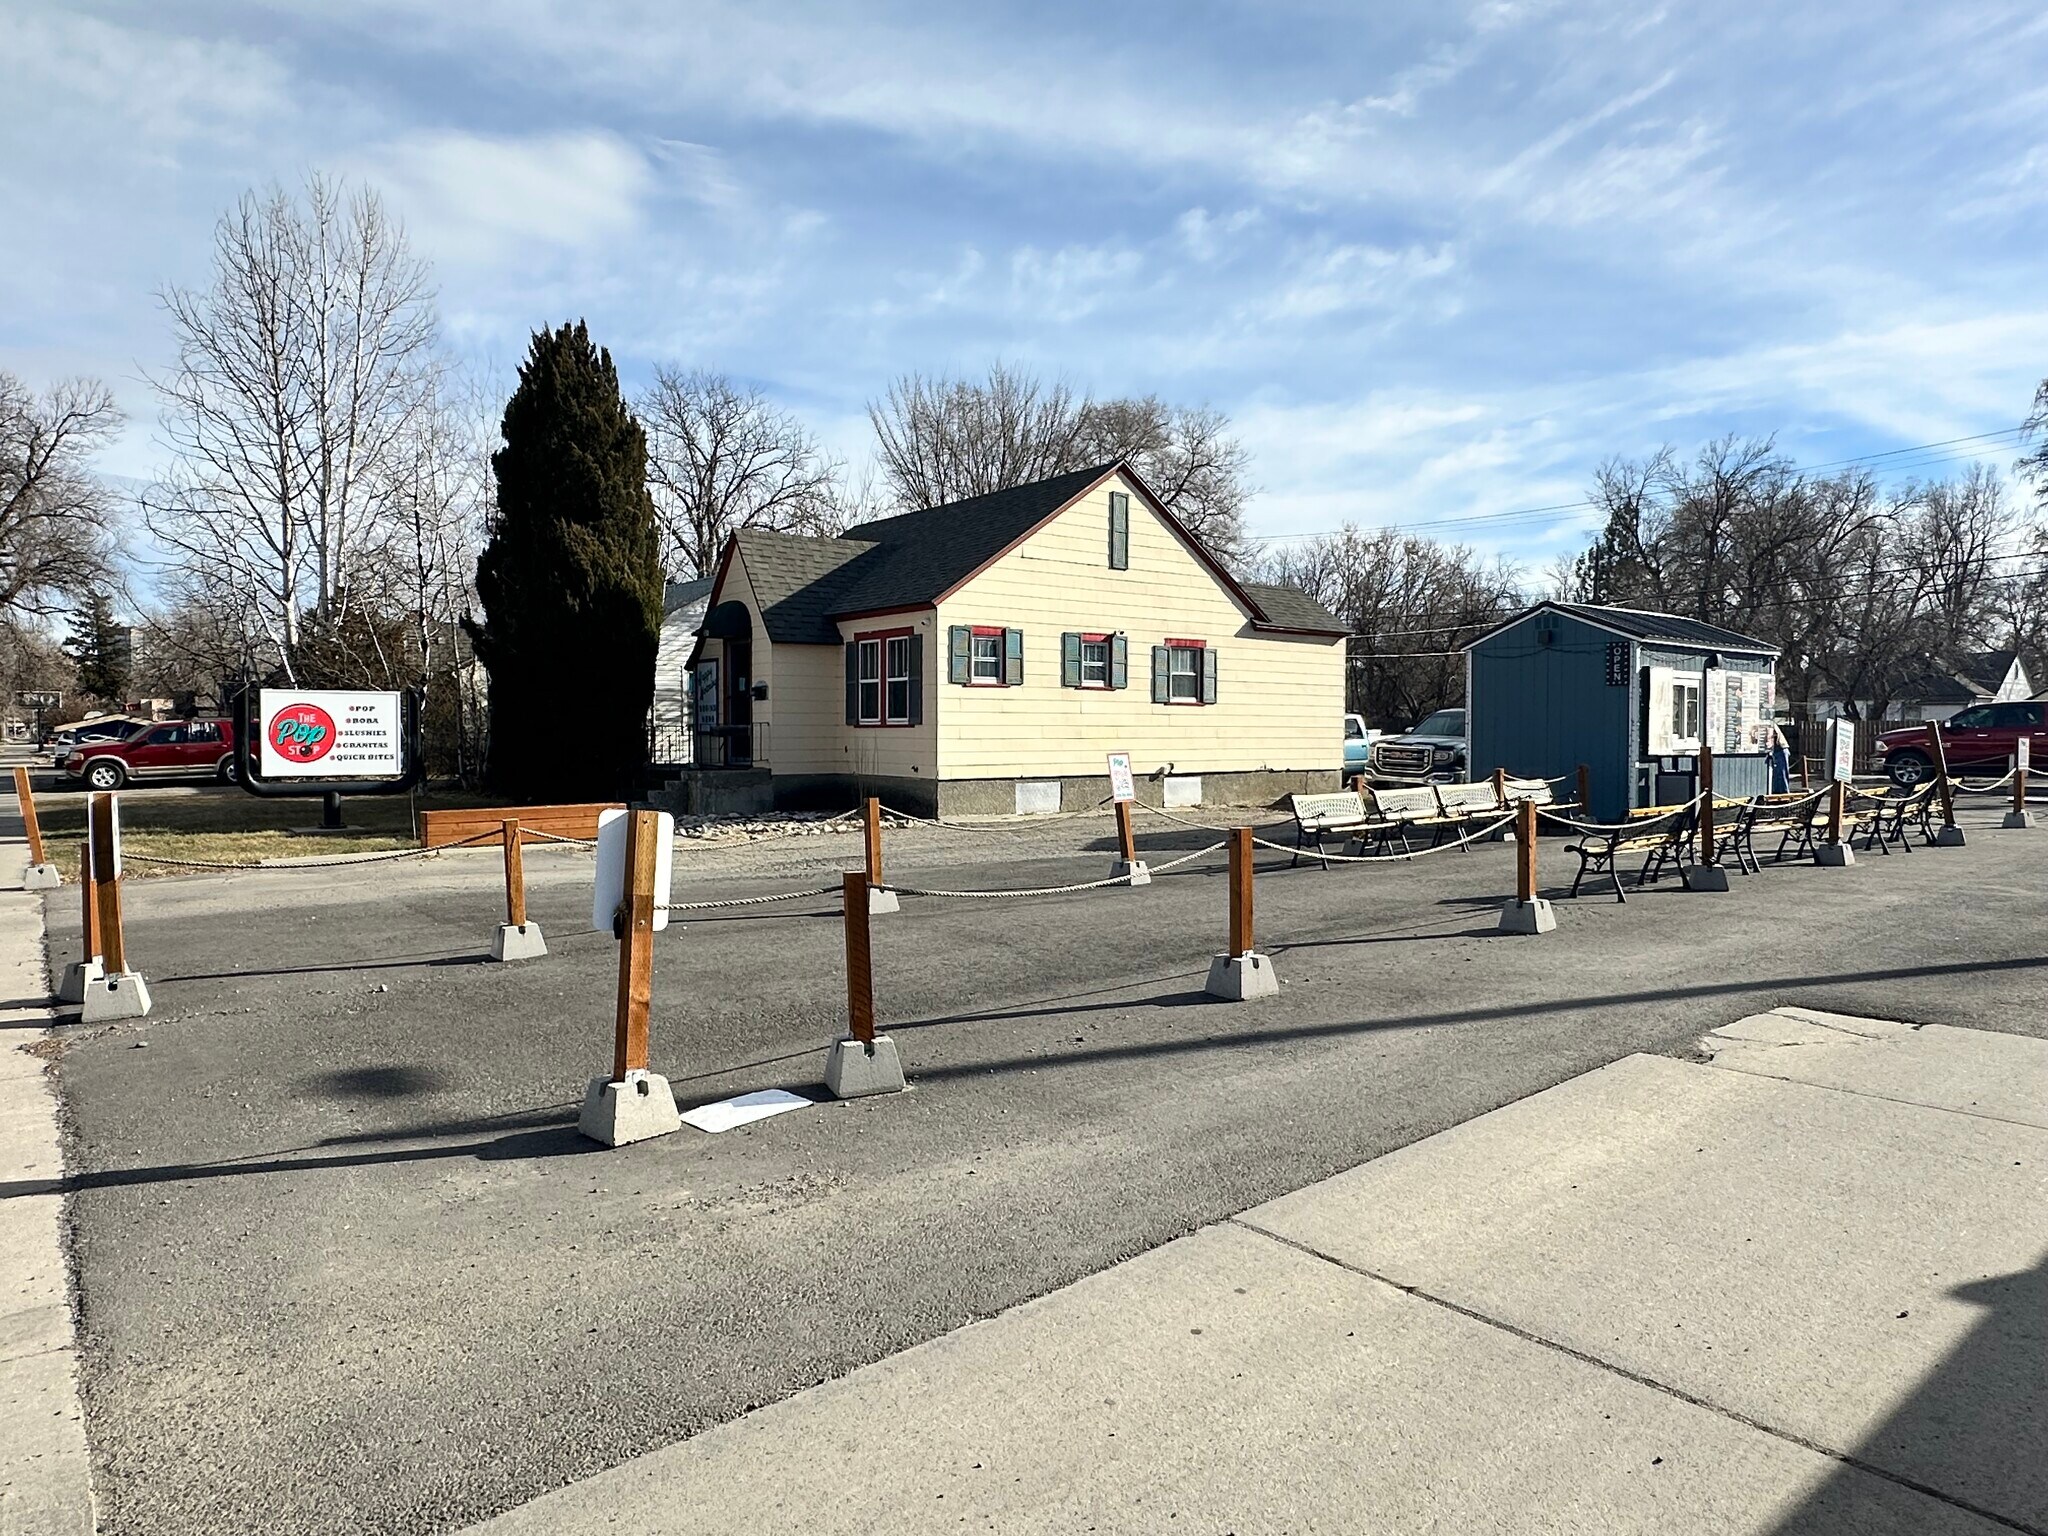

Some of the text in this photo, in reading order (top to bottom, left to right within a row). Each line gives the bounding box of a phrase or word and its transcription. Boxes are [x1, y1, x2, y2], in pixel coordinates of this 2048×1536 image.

[1613, 647, 1622, 681] OPEN
[298, 712, 317, 723] THE
[276, 718, 327, 746] Pop
[336, 753, 395, 762] QUICK BITES
